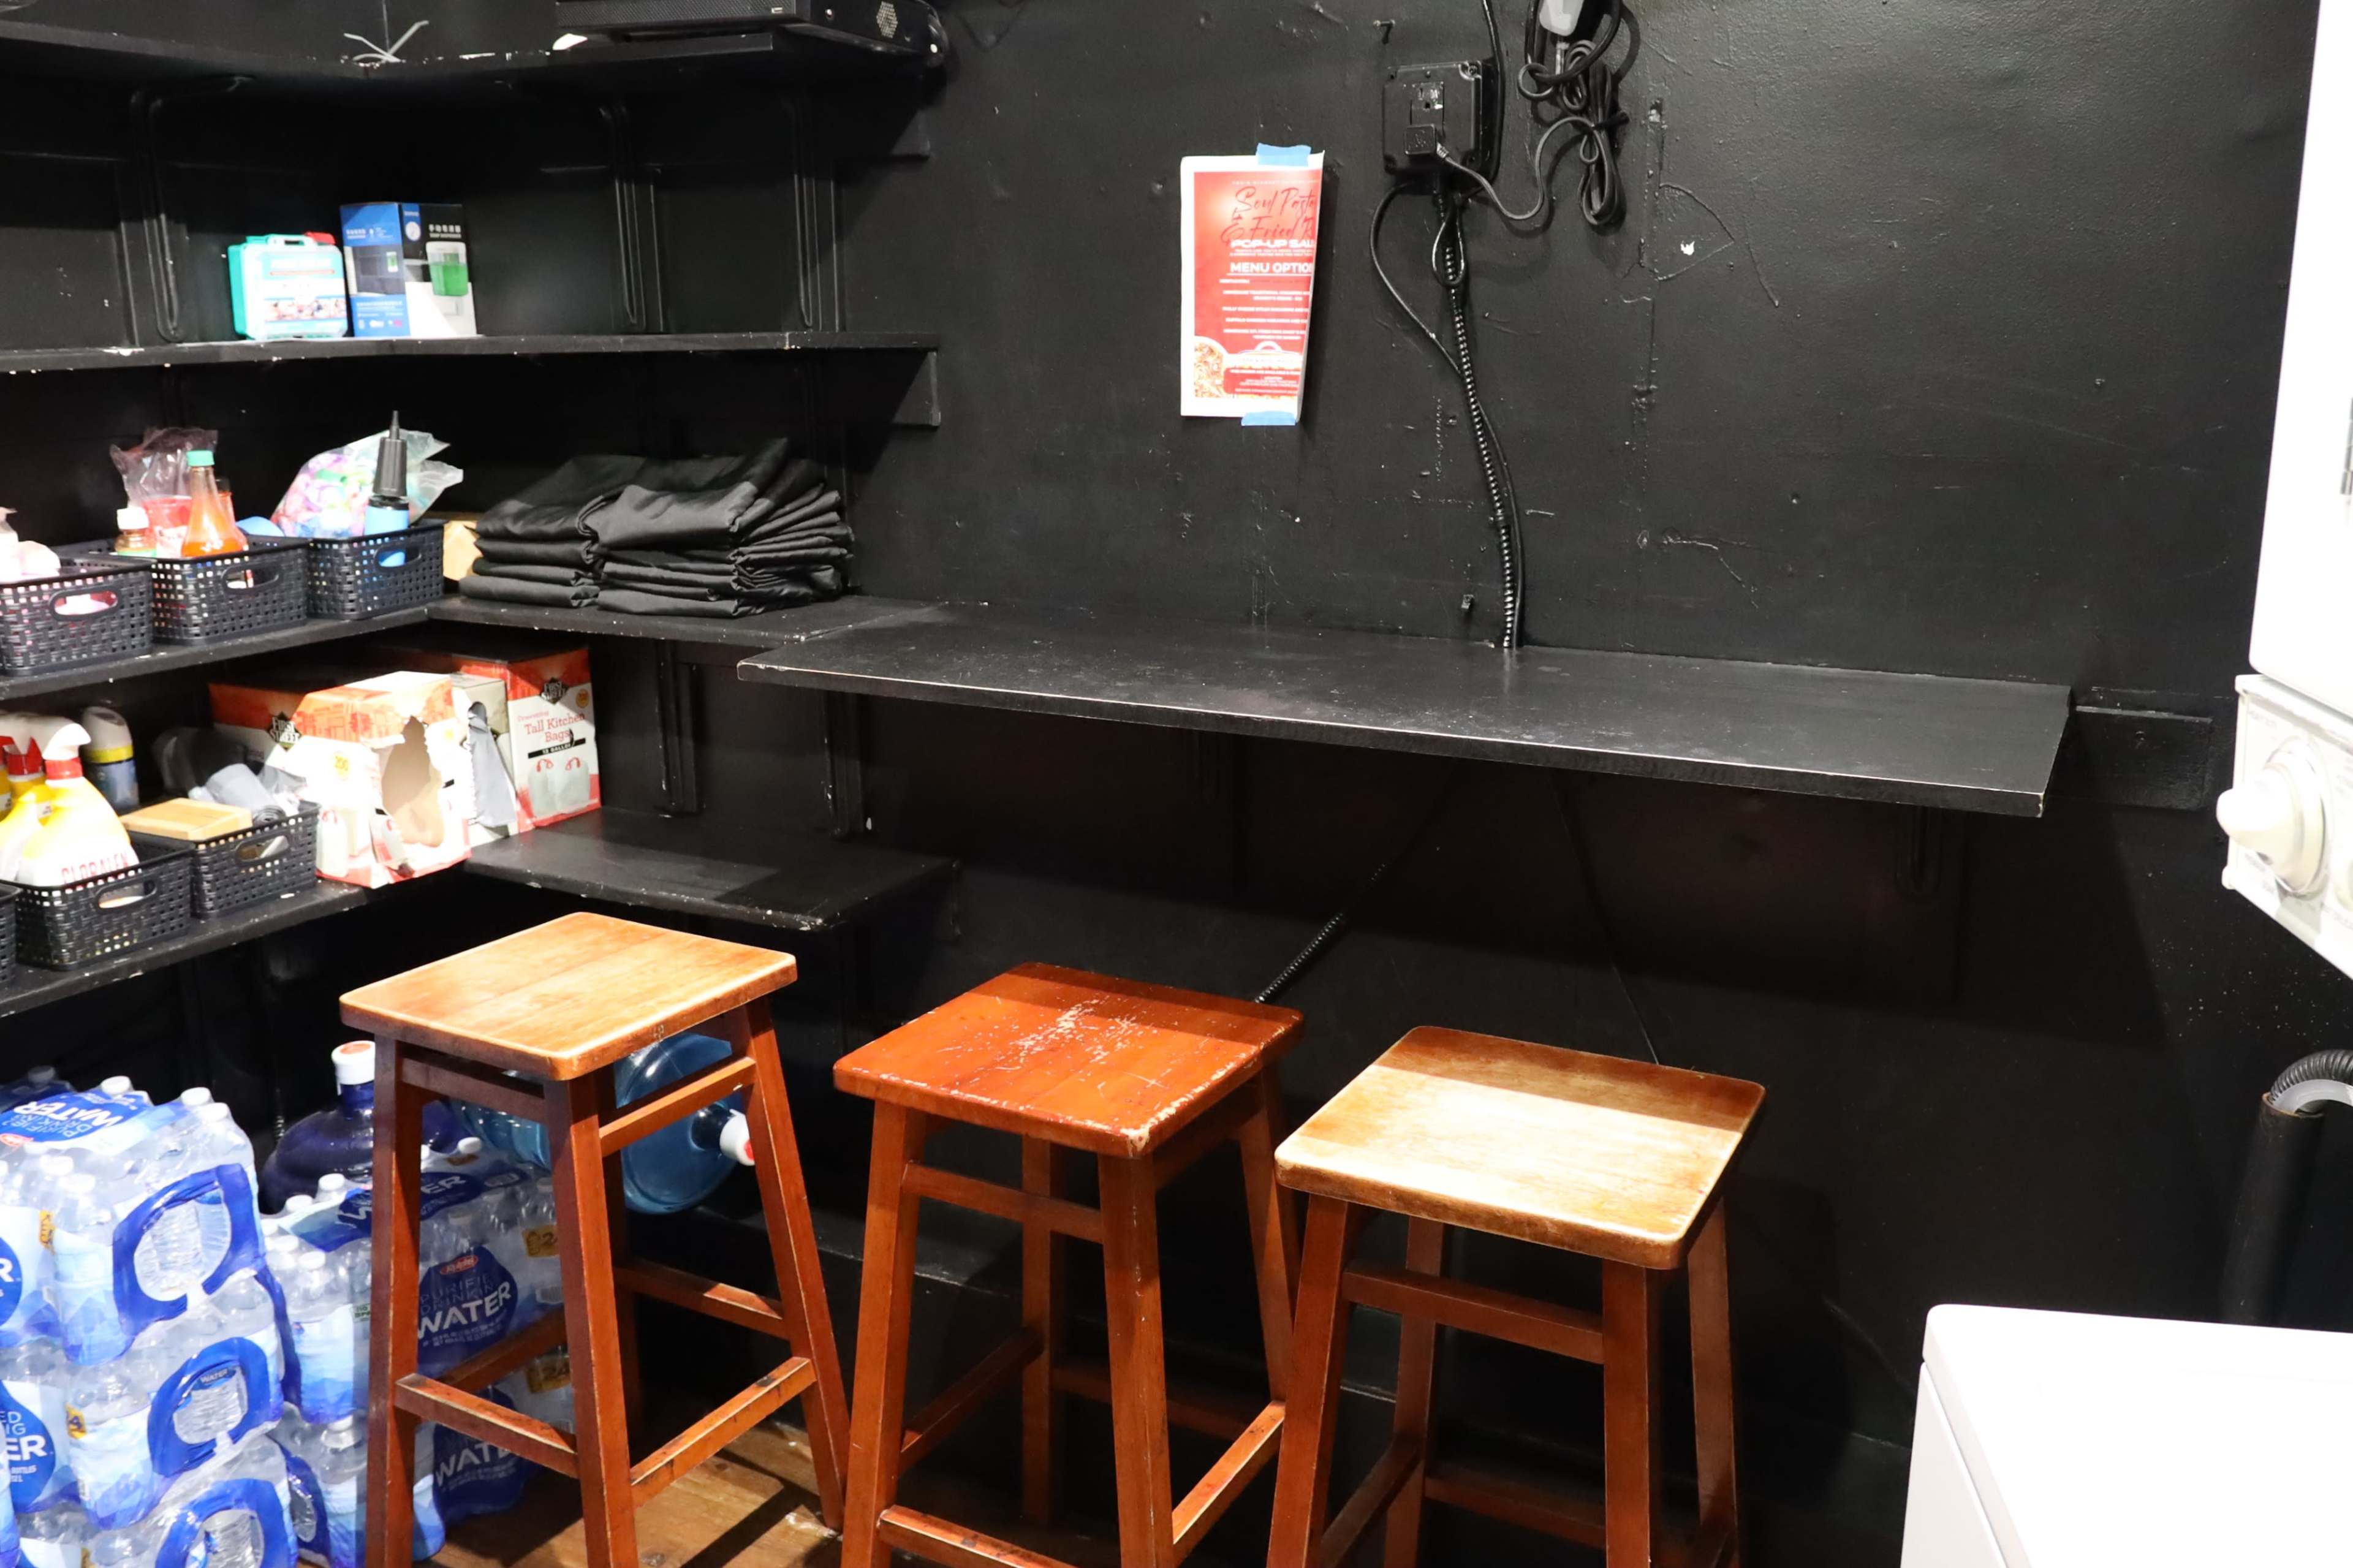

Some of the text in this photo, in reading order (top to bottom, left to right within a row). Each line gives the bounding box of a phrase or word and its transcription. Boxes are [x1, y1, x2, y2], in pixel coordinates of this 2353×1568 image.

[1230, 262, 1270, 273] MENU
[525, 713, 585, 735] Tall Kitchen
[545, 729, 570, 743] Bags
[13, 1102, 124, 1127] WATER
[418, 1281, 512, 1339] WATER
